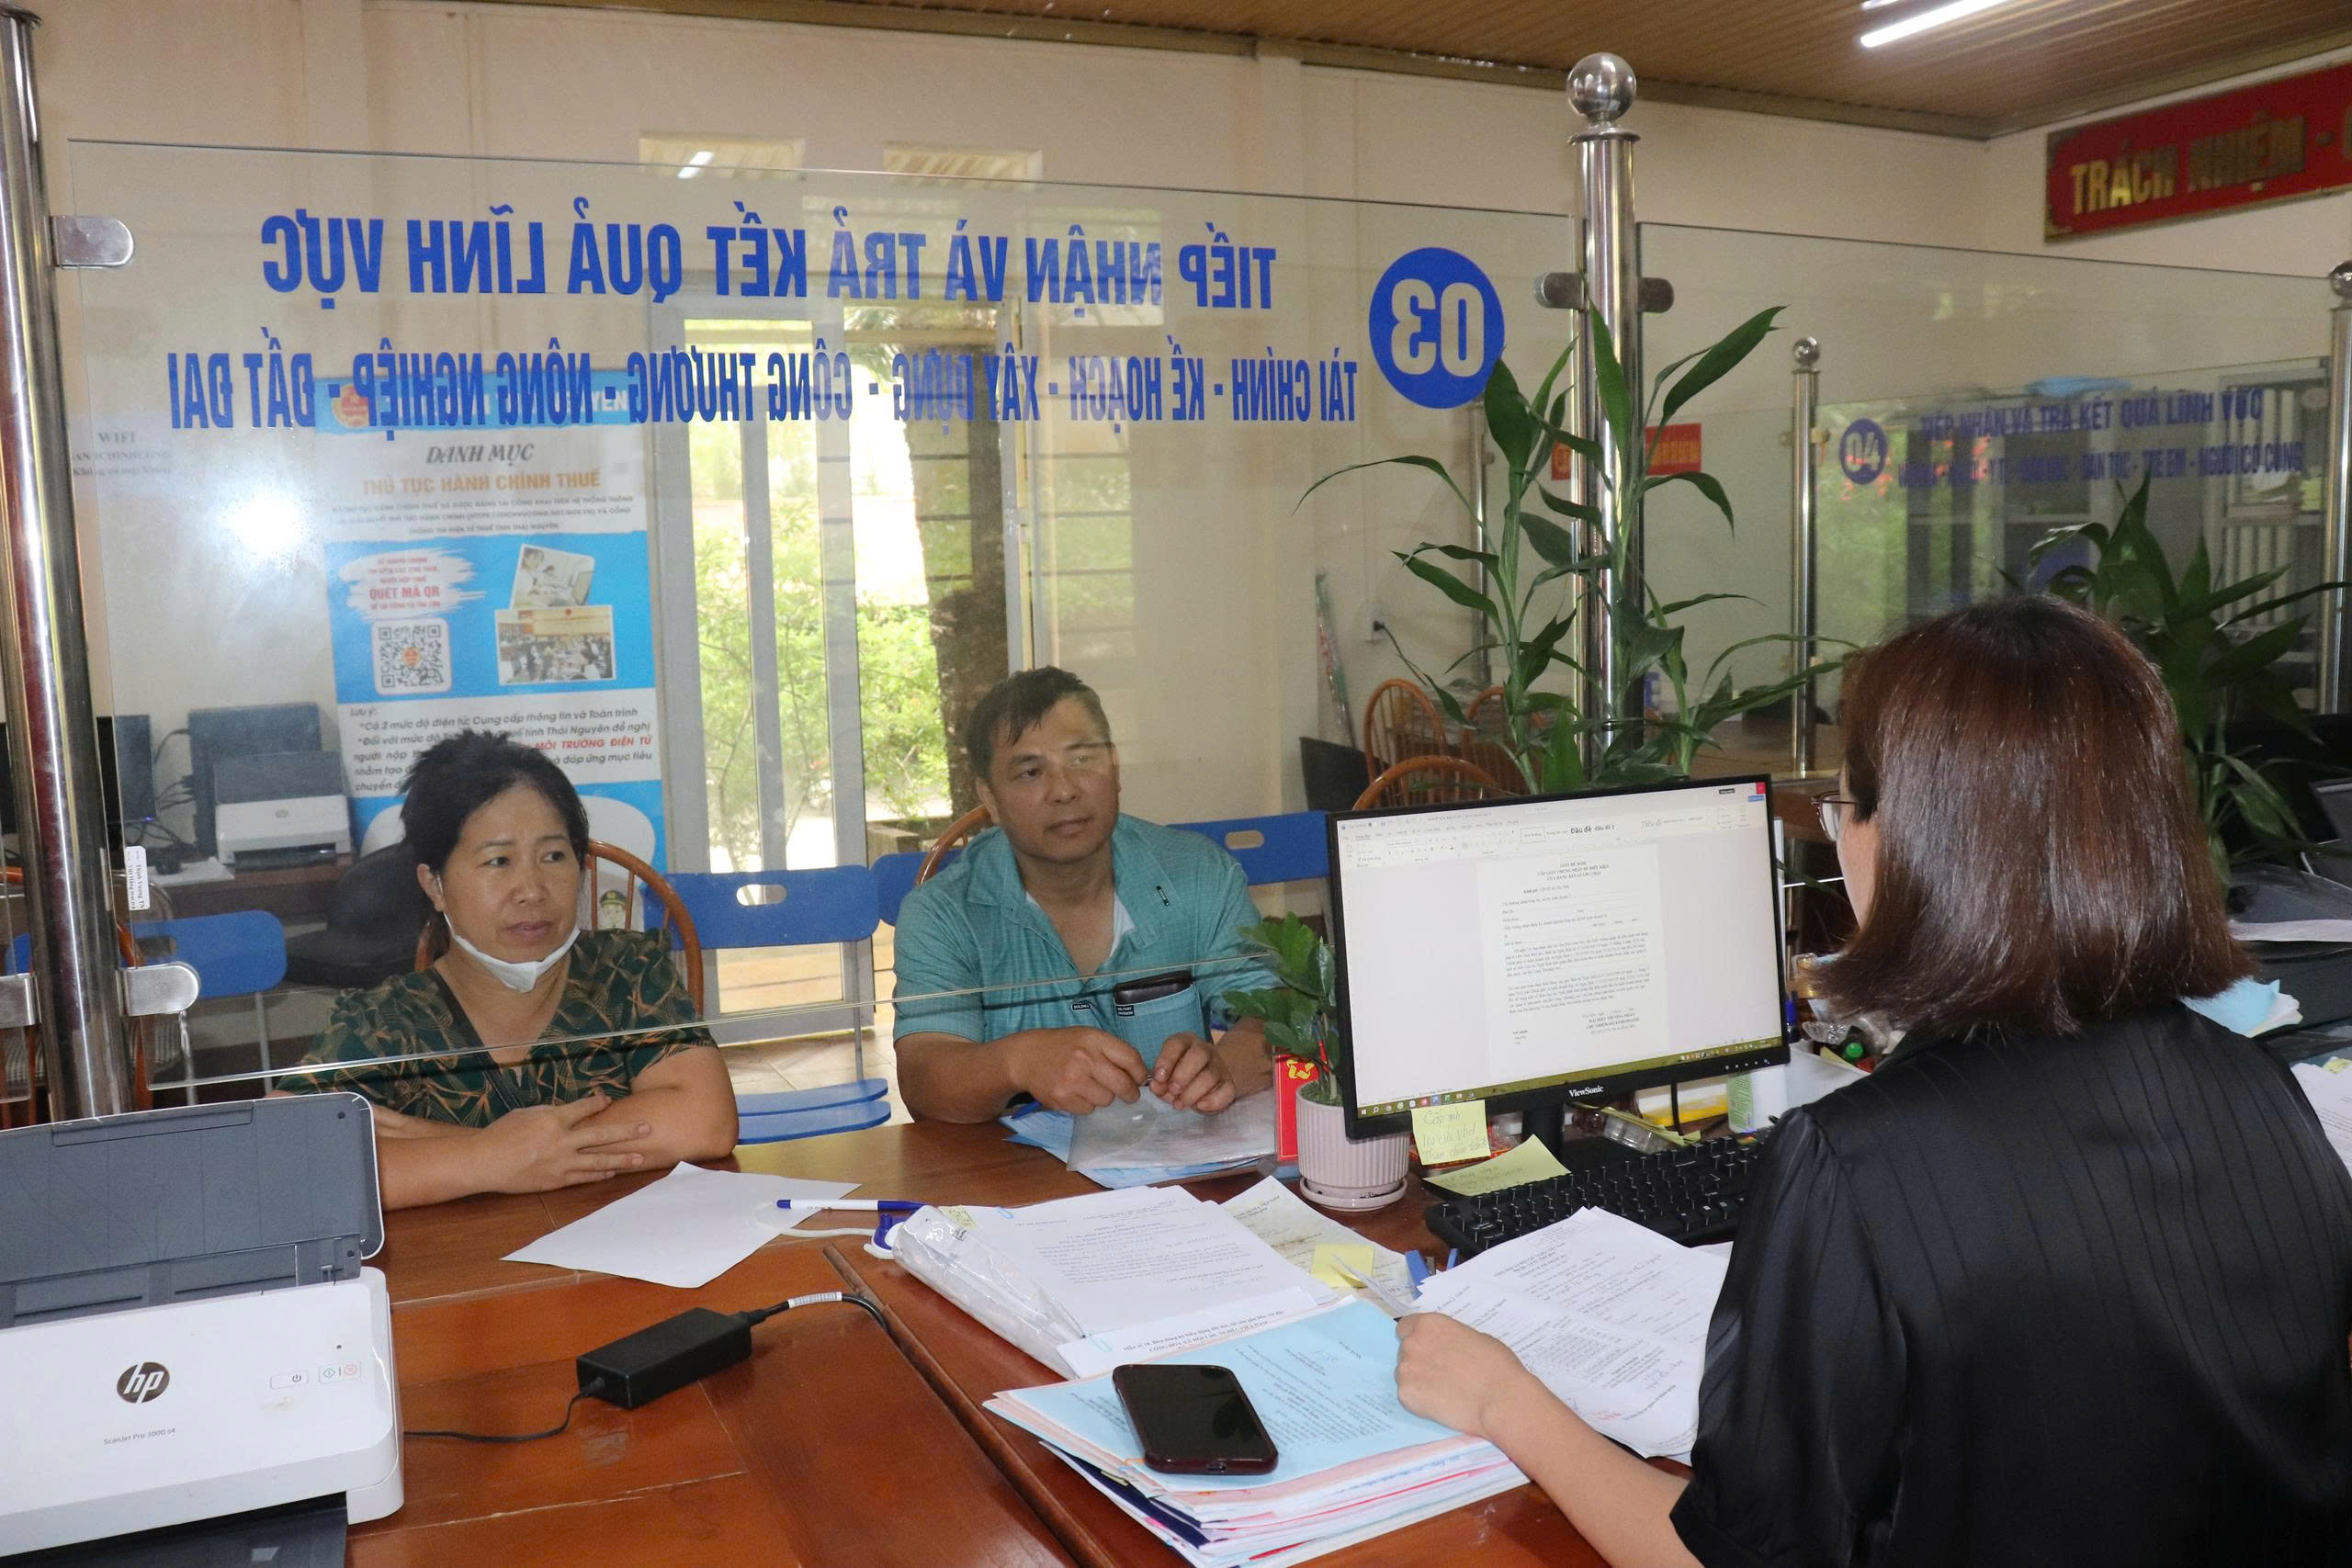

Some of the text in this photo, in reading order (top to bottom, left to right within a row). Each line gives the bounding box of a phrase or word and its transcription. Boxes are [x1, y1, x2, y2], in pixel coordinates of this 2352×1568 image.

[2071, 137, 2179, 215] TRÁCH
[98, 432, 136, 444] WIFI
[426, 443, 535, 467] DANH MỤC
[1844, 431, 1882, 474] 04
[362, 467, 601, 497] THỦ TỤC HÀNH CHÍNH THUẾ
[390, 718, 413, 729] mức
[415, 717, 429, 729] độ
[432, 716, 455, 728] điện
[472, 715, 501, 727] Cung
[503, 712, 525, 725] cấp
[526, 711, 557, 724] thông
[559, 711, 571, 720] tin
[573, 710, 587, 719] và
[588, 709, 613, 719] Toàn
[615, 707, 638, 717] trình
[400, 733, 424, 744] mức
[570, 724, 610, 737] Nguyên
[561, 737, 605, 749] TRƯỜNG
[610, 736, 635, 747] ĐIỆN
[562, 753, 584, 765] đáp
[585, 752, 606, 765] ứng
[607, 751, 630, 764] mục
[1568, 1084, 1604, 1098] ViewSonic
[122, 1361, 165, 1404] hp
[103, 1427, 175, 1445] ScanJet Pro 3000 s4
